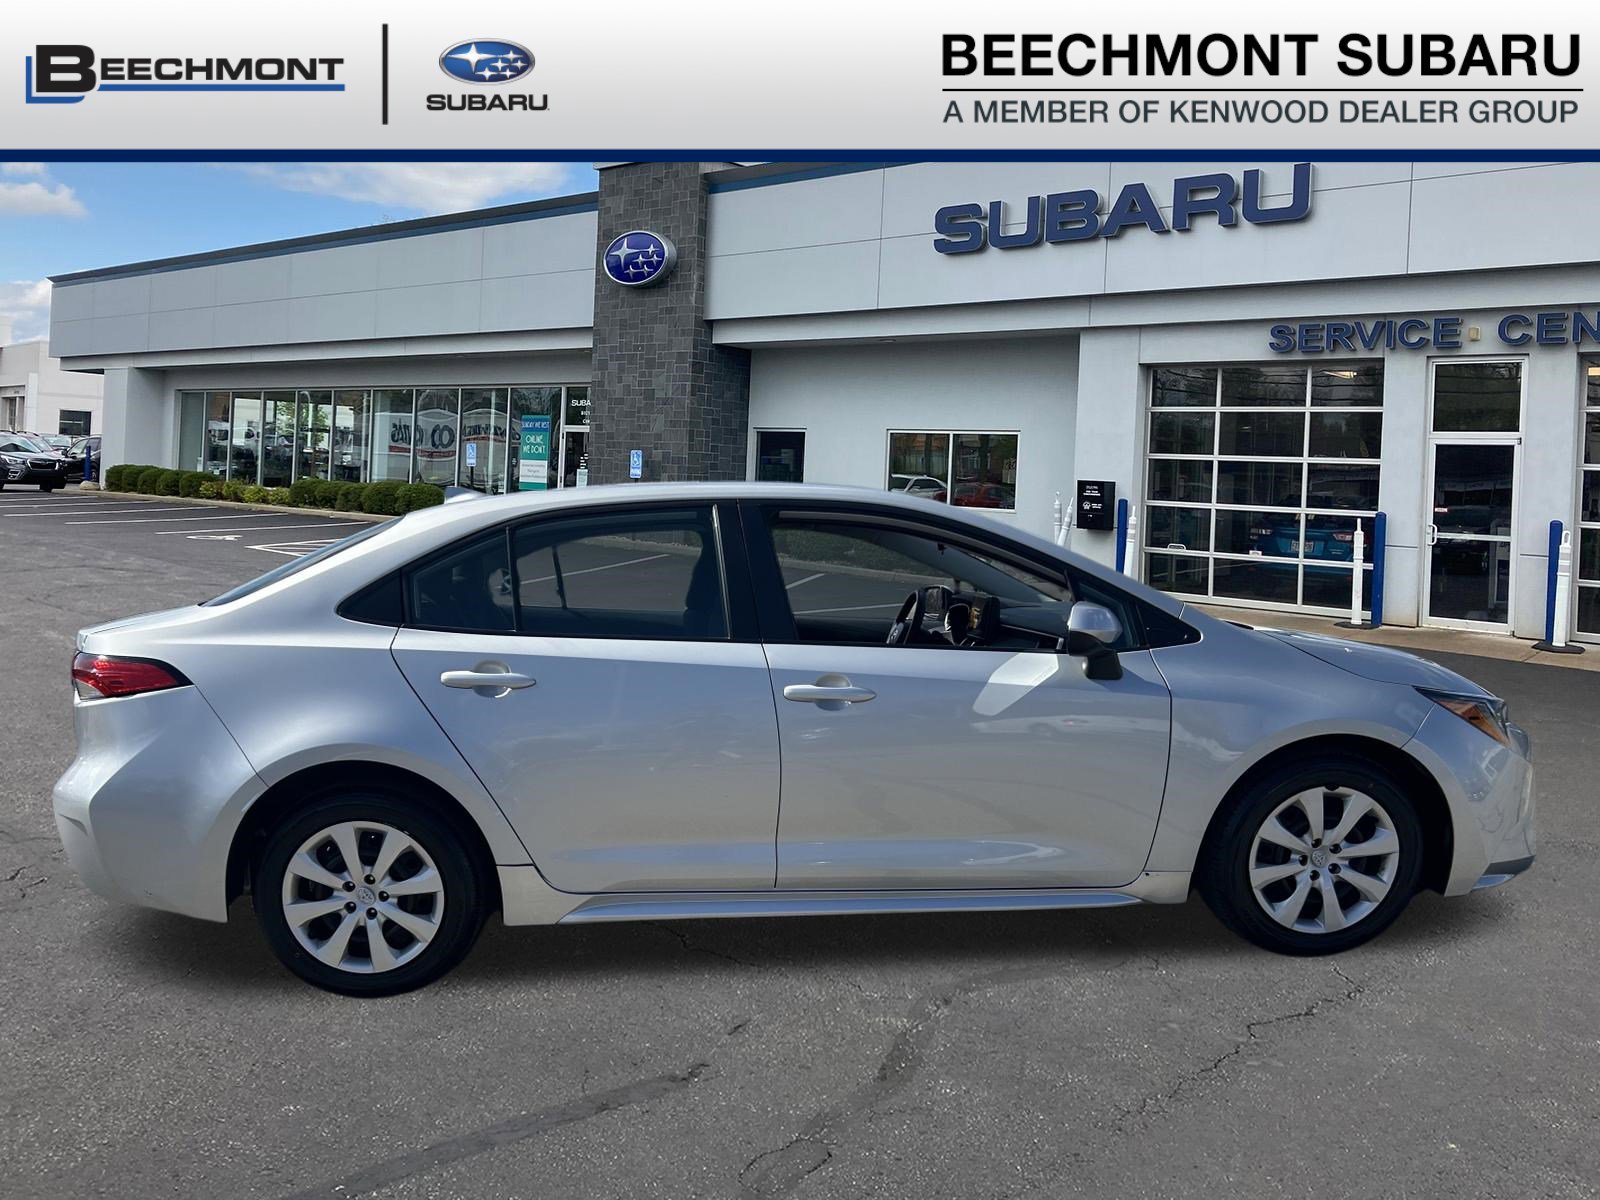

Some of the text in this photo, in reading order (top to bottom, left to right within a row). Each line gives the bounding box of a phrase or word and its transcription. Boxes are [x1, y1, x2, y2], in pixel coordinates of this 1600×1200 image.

[933, 162, 1313, 255] SUBARU
[1269, 311, 1600, 353] SERVICE CEN
